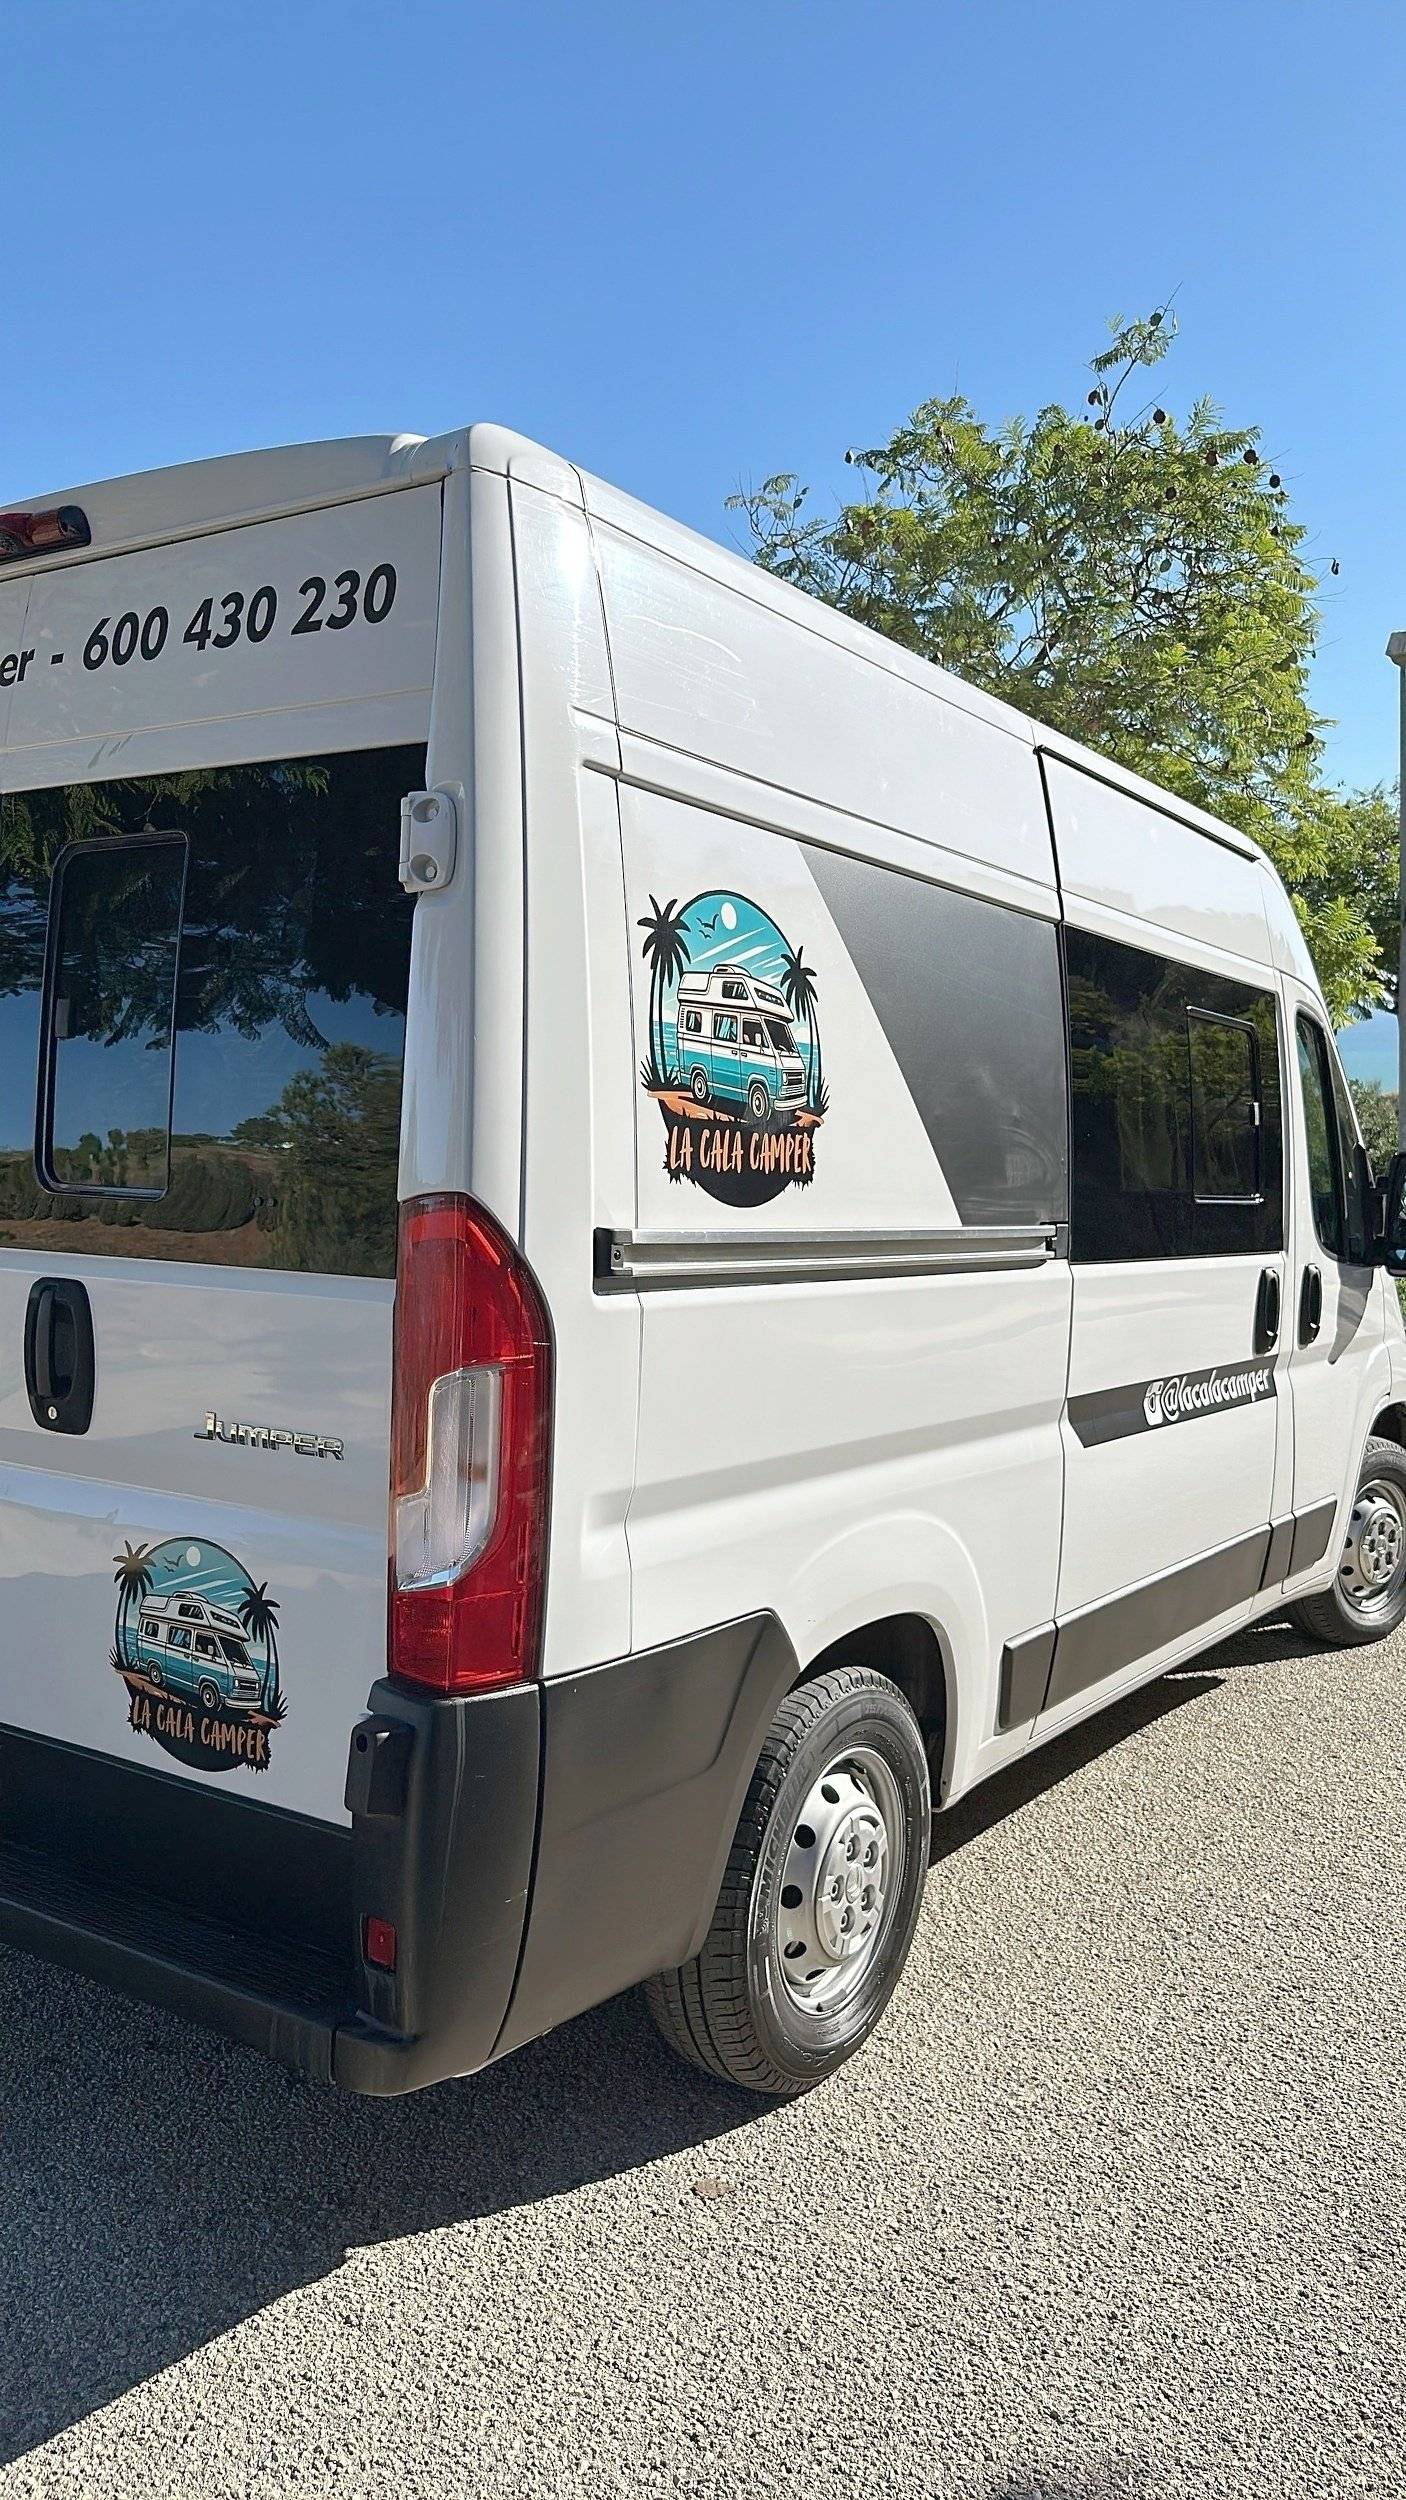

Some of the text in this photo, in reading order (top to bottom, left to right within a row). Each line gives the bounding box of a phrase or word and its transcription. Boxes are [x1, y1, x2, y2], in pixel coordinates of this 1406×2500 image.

[83, 606, 168, 671] 600
[183, 586, 278, 651] 430
[291, 563, 397, 636] 230
[670, 1125, 812, 1175] LA CALA CAMPER
[1161, 1369, 1270, 1422] @lacalacamper
[132, 1695, 266, 1761] LA CALA CAMPER
